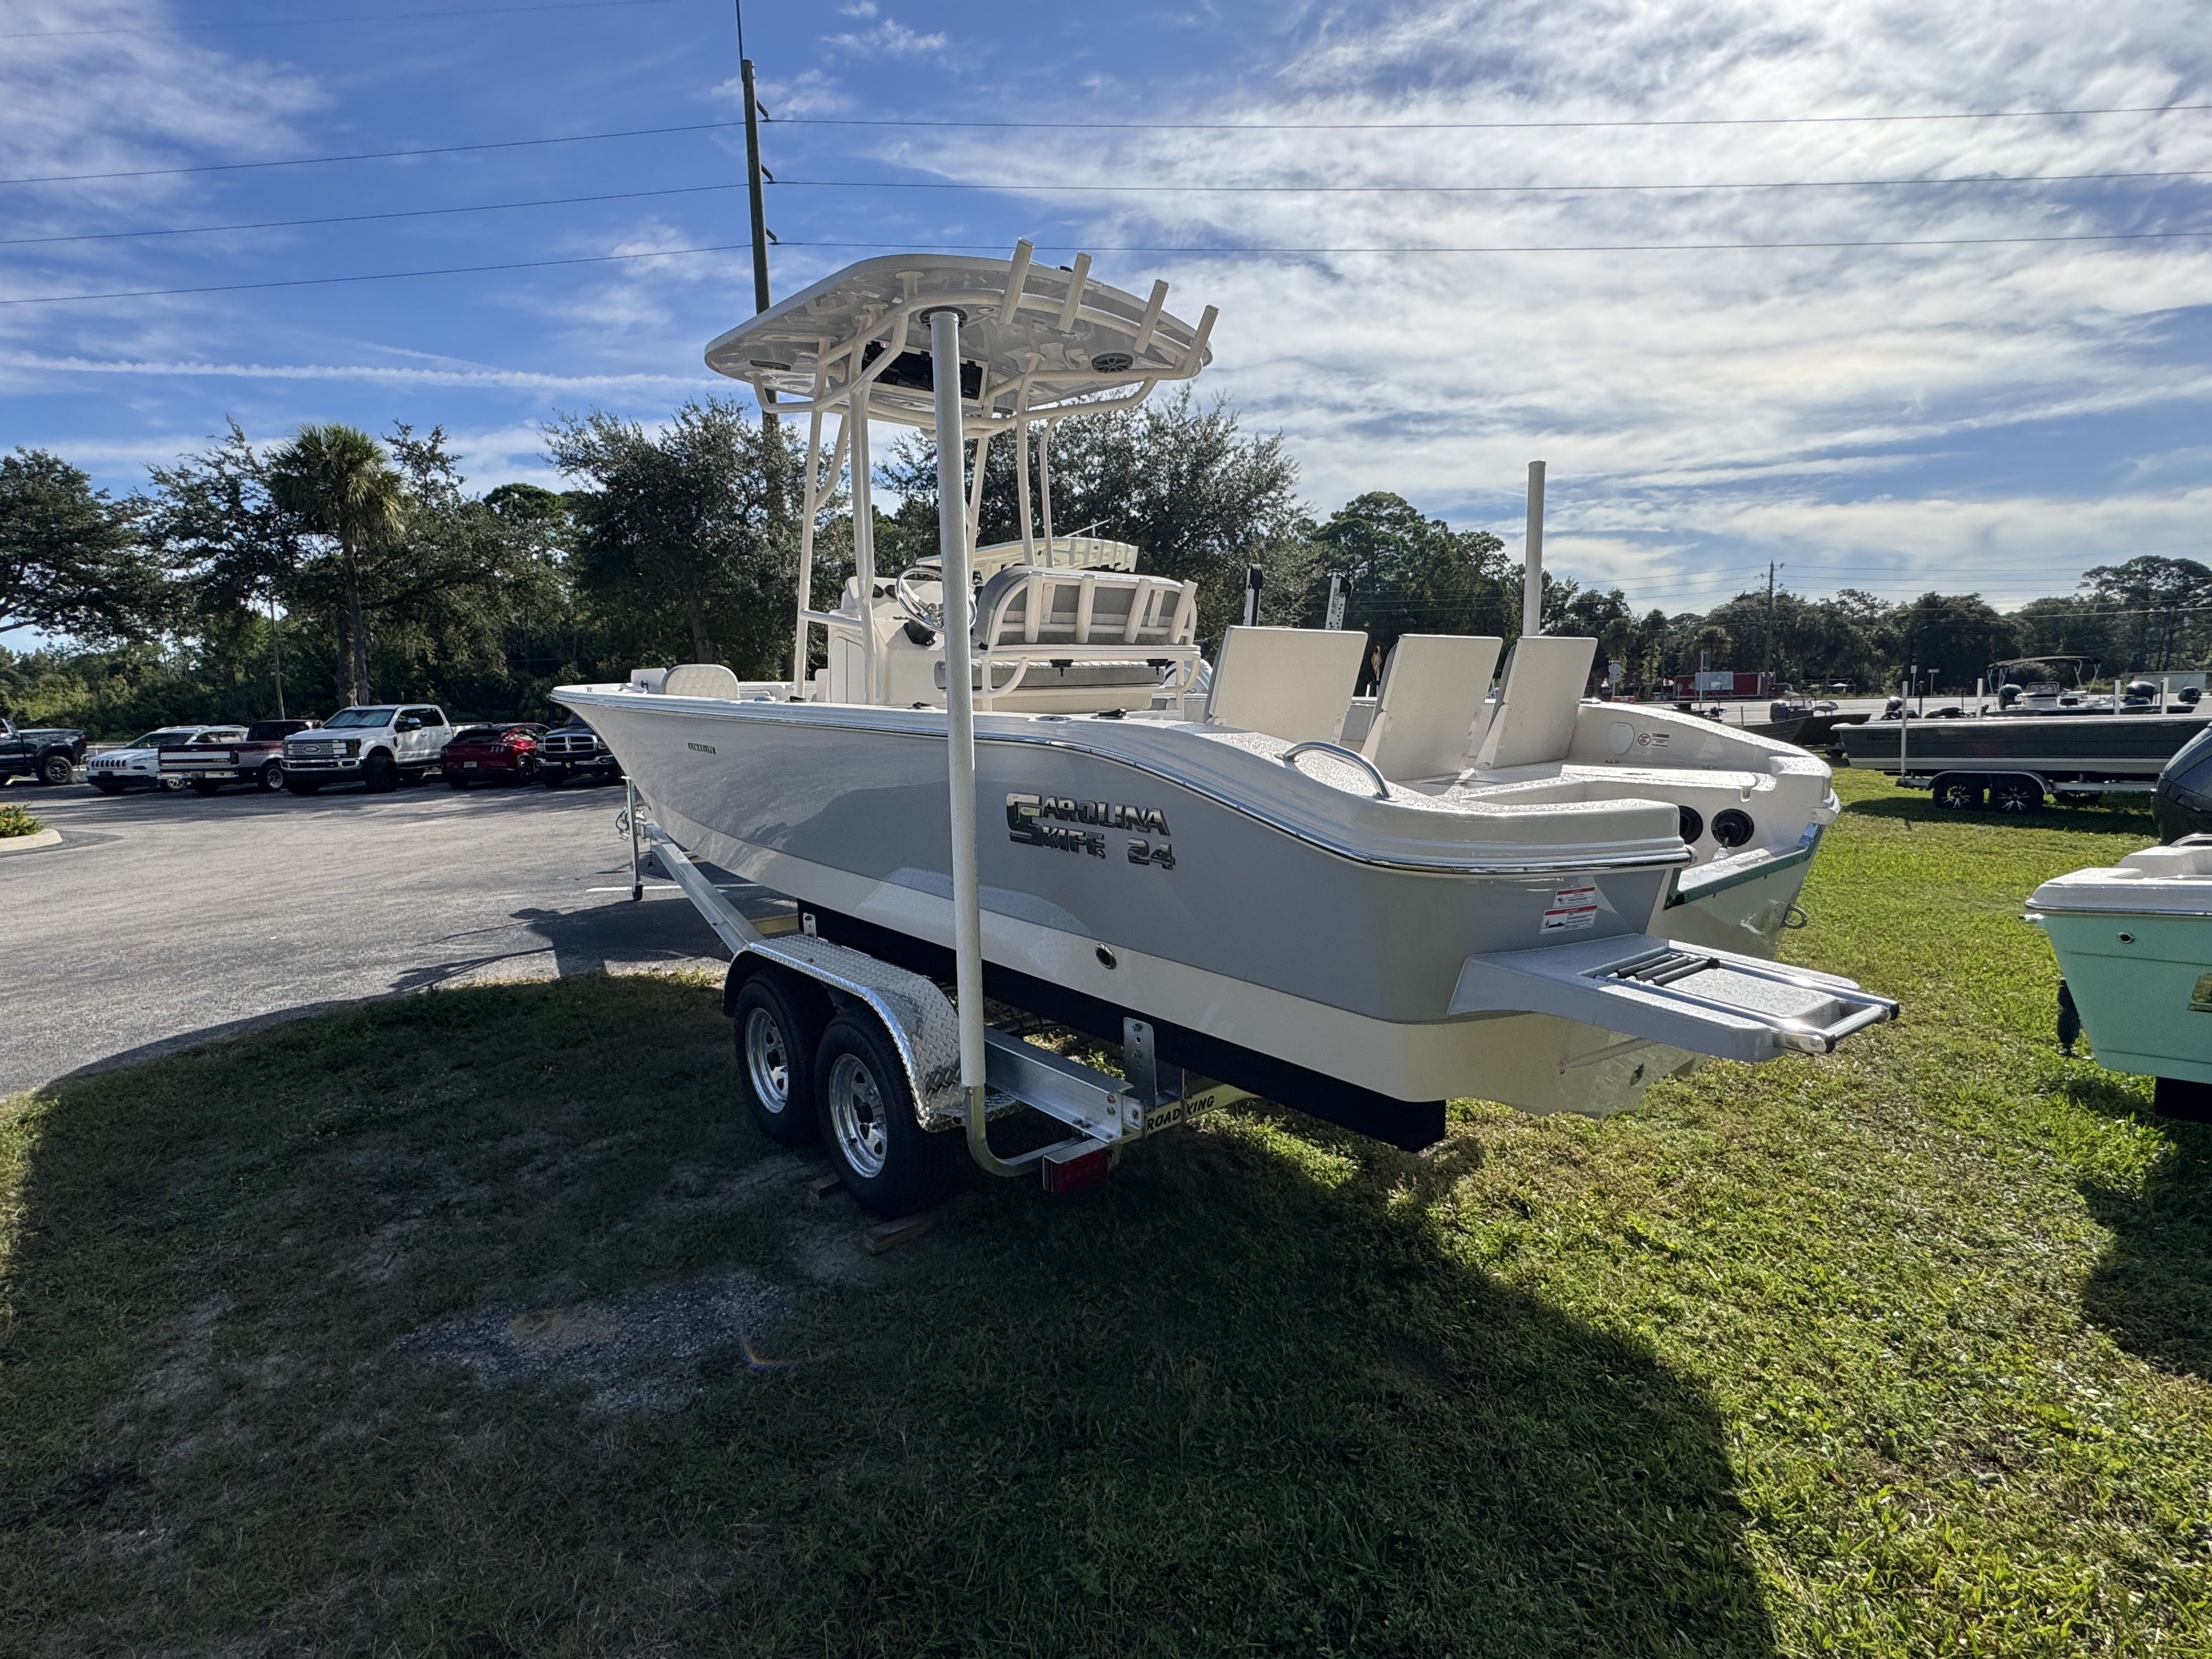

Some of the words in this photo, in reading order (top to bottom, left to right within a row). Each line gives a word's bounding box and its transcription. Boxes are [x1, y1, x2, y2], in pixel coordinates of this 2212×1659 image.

[1006, 792, 1171, 836] CAROLINA
[1008, 805, 1105, 857] SKIFF
[1127, 837, 1176, 870] 24
[1147, 1108, 1181, 1131] ROAD
[1186, 1095, 1215, 1115] KING
